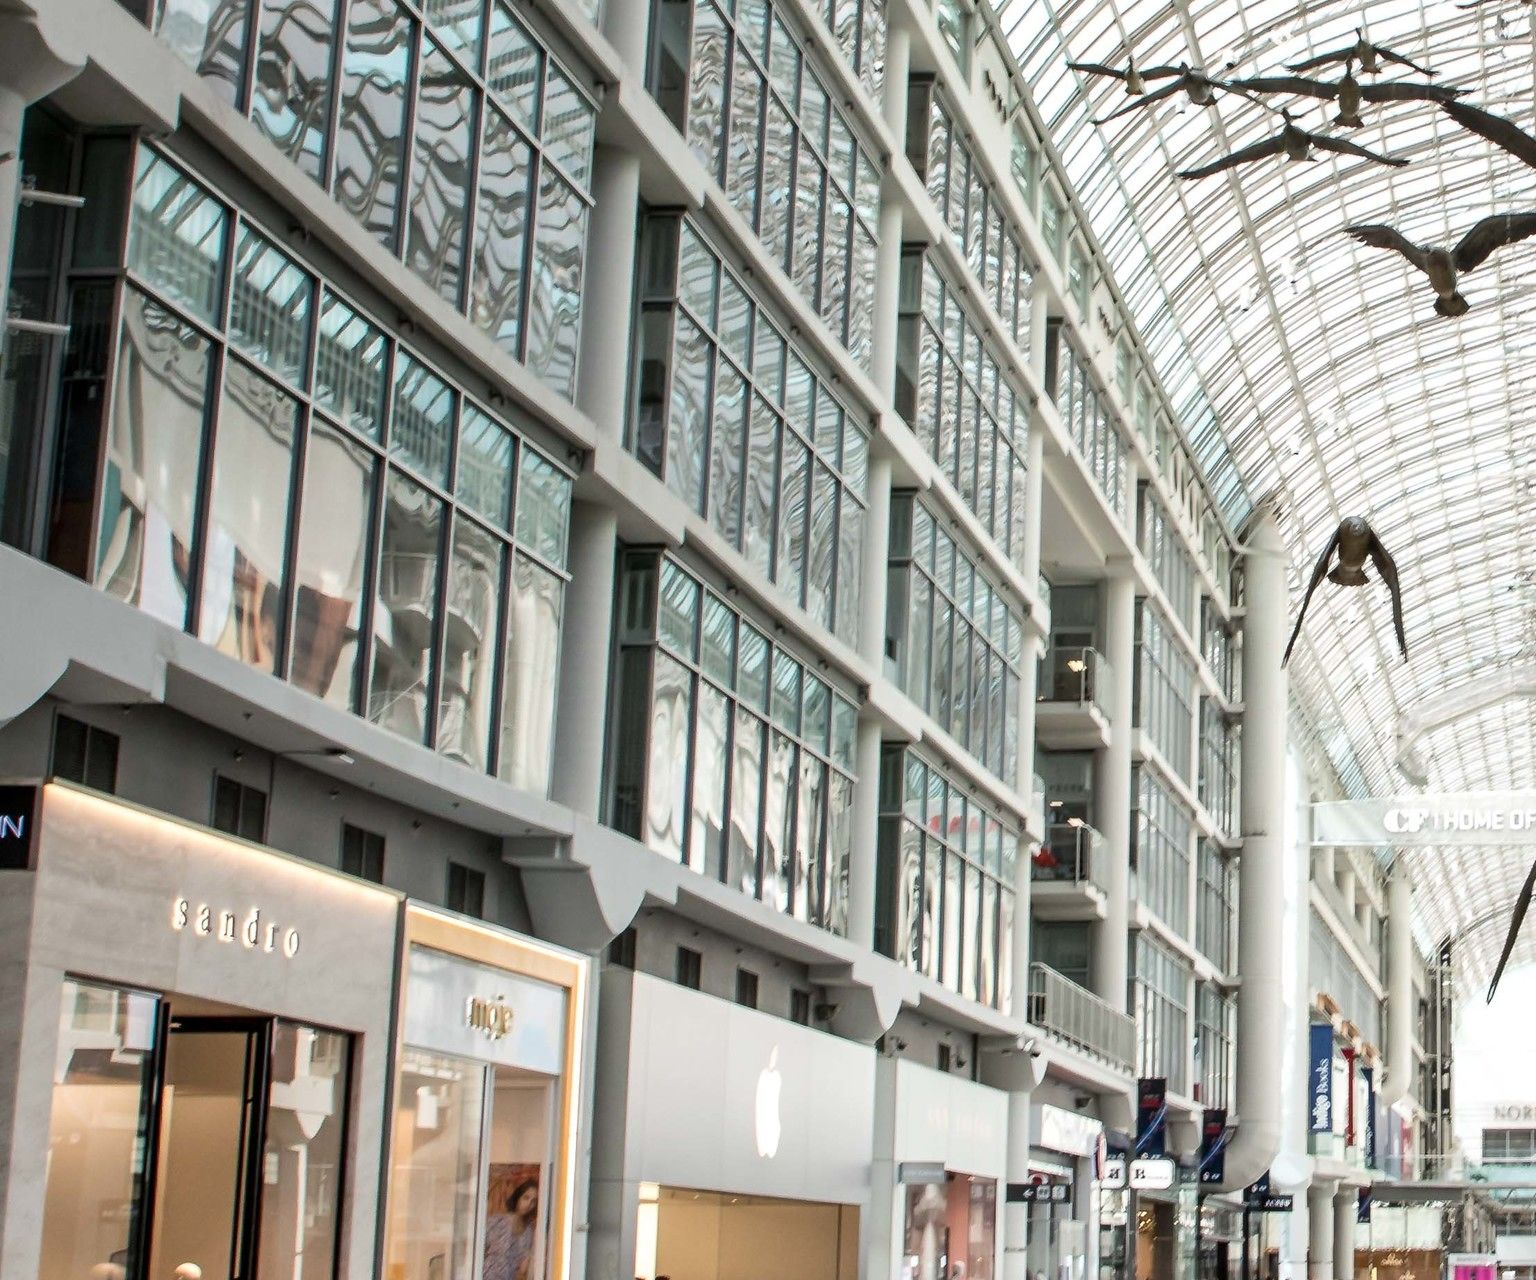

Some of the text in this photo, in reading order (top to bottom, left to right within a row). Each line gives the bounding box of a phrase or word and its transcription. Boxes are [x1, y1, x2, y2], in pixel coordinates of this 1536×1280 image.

[1444, 809, 1504, 830] HOME
[174, 897, 300, 959] sandro
[1312, 1057, 1331, 1130] Indigo Books
